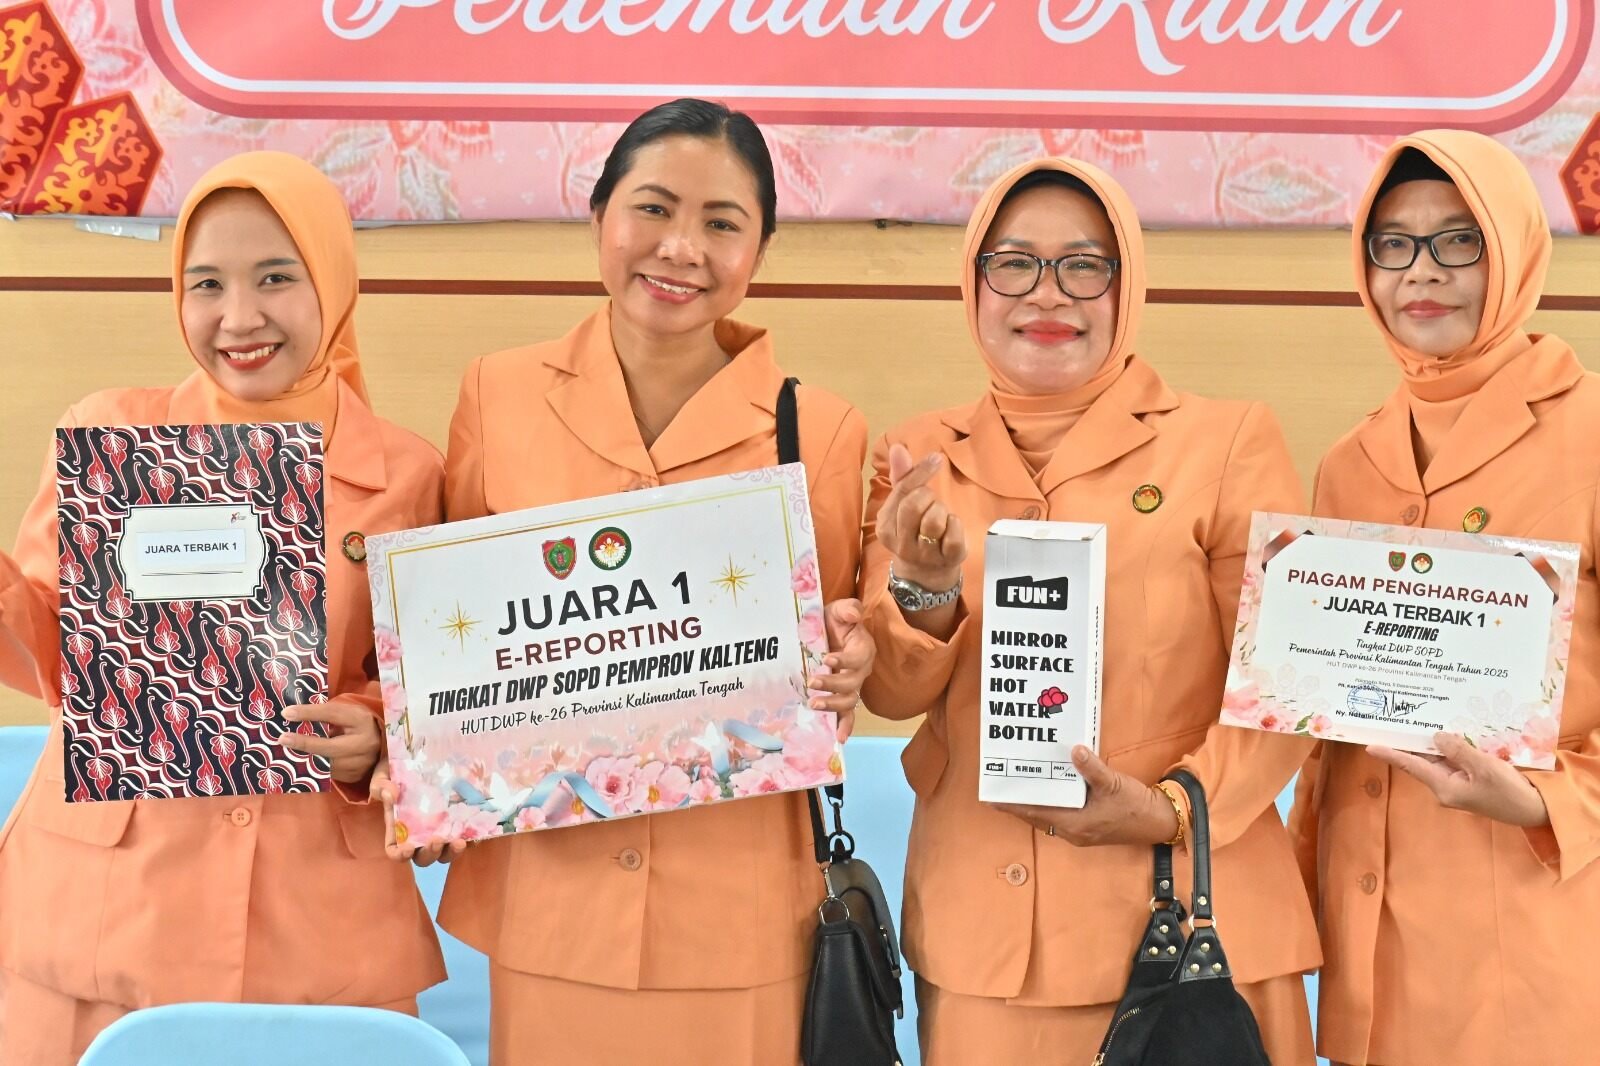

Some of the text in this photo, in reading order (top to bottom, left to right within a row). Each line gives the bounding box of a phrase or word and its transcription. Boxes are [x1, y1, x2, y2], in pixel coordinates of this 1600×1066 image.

[145, 542, 238, 554] JUARA TERBAIK 1
[1007, 585, 1061, 604] FUN+
[1288, 569, 1529, 608] PIAGAM PENGHARGAAN
[497, 571, 692, 636] JUARA 1
[1323, 596, 1486, 628] JUARA TERBAIK 1
[991, 630, 1068, 649] MIRROR
[1363, 621, 1440, 641] E-REPORTING
[495, 616, 702, 671] E-REPORTING
[1356, 639, 1444, 658] Tingkat DWP SOPD
[990, 654, 1075, 673] SURFACE
[1289, 643, 1509, 678] Pemerintah Provinsi Kalimantan Tengah Tahun 2025
[428, 636, 779, 716] TINGKAT DWP SOPD PEMPROV KALTENG
[1378, 667, 1405, 675] Provinsi
[1405, 670, 1442, 680] Kalimantan
[1443, 675, 1467, 683] Tengah
[990, 678, 1028, 694] HOT
[461, 677, 745, 735] HUT DWP ke-26 Provinsi Kalimantan Tengah
[989, 701, 1051, 719] WATER
[1375, 715, 1404, 724] Leonard
[1412, 720, 1444, 730] Ampung
[989, 724, 1058, 743] BOTTLE
